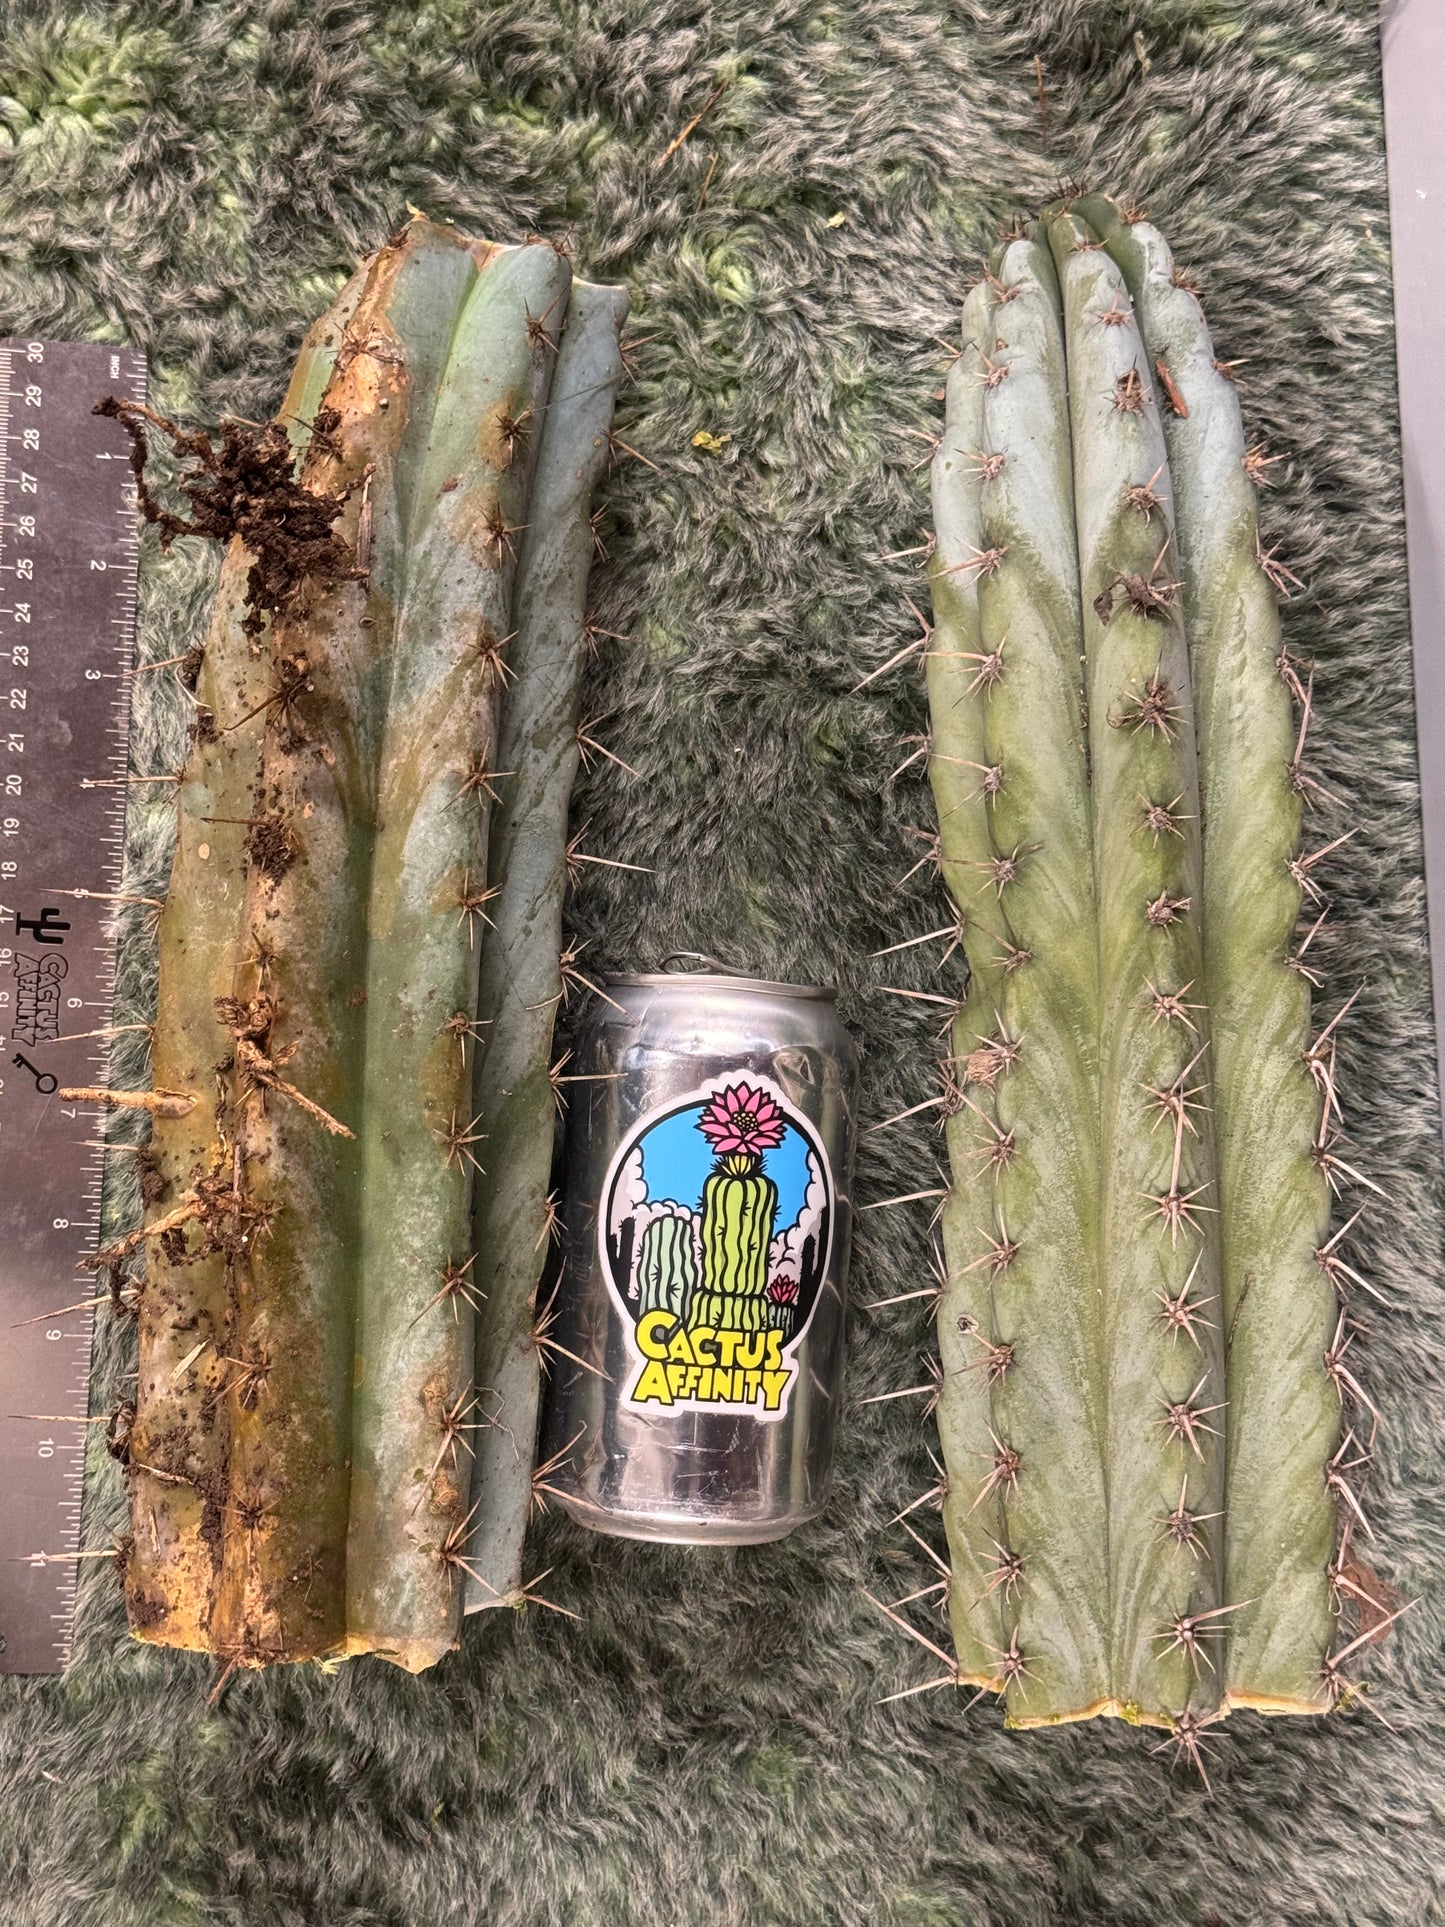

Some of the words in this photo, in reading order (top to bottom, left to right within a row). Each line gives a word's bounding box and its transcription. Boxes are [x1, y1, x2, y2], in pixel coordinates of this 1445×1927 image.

[27, 342, 44, 363] 30
[110, 355, 120, 379] INCH
[26, 385, 42, 407] 29
[23, 429, 40, 450] 28
[96, 452, 112, 460] 1
[21, 472, 37, 494] 27
[19, 515, 35, 537] 26
[17, 558, 33, 580] 25
[90, 560, 106, 571] 2
[15, 603, 31, 623] 24
[13, 645, 29, 667] 23
[85, 669, 101, 680] 3
[10, 688, 27, 710] 22
[8, 733, 24, 753] 21
[6, 774, 22, 796] 20
[3, 817, 20, 837] 19
[1, 860, 17, 880] 18
[0, 904, 14, 924] 17
[12, 952, 41, 1047] AFFINITY
[35, 952, 69, 1041] CACTUS
[67, 997, 83, 1008] 6
[61, 1108, 76, 1119] 7
[53, 1218, 69, 1229] 8
[46, 1329, 62, 1340] 9
[635, 1308, 785, 1371] CACTUS
[631, 1360, 793, 1411] AFFINITY
[38, 1437, 54, 1457] 10
